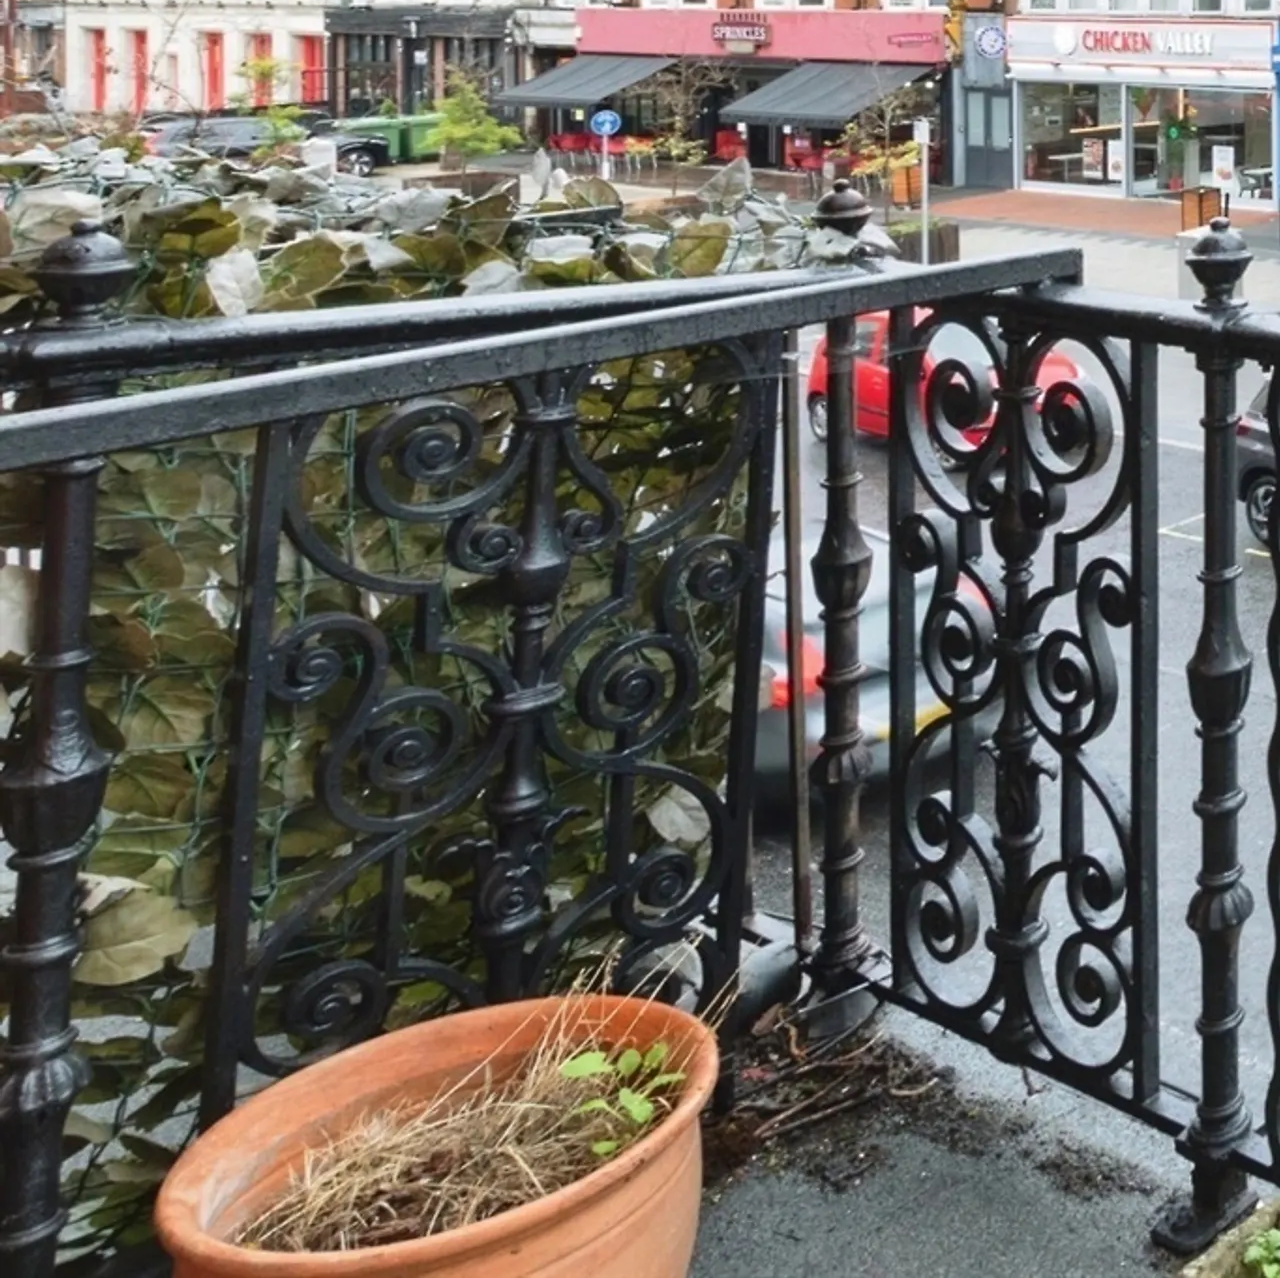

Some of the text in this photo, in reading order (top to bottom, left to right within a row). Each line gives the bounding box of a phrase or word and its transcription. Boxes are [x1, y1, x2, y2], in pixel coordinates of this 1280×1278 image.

[713, 25, 766, 41] SPRINKLES
[1082, 29, 1215, 56] CHICKEN VALLEY
